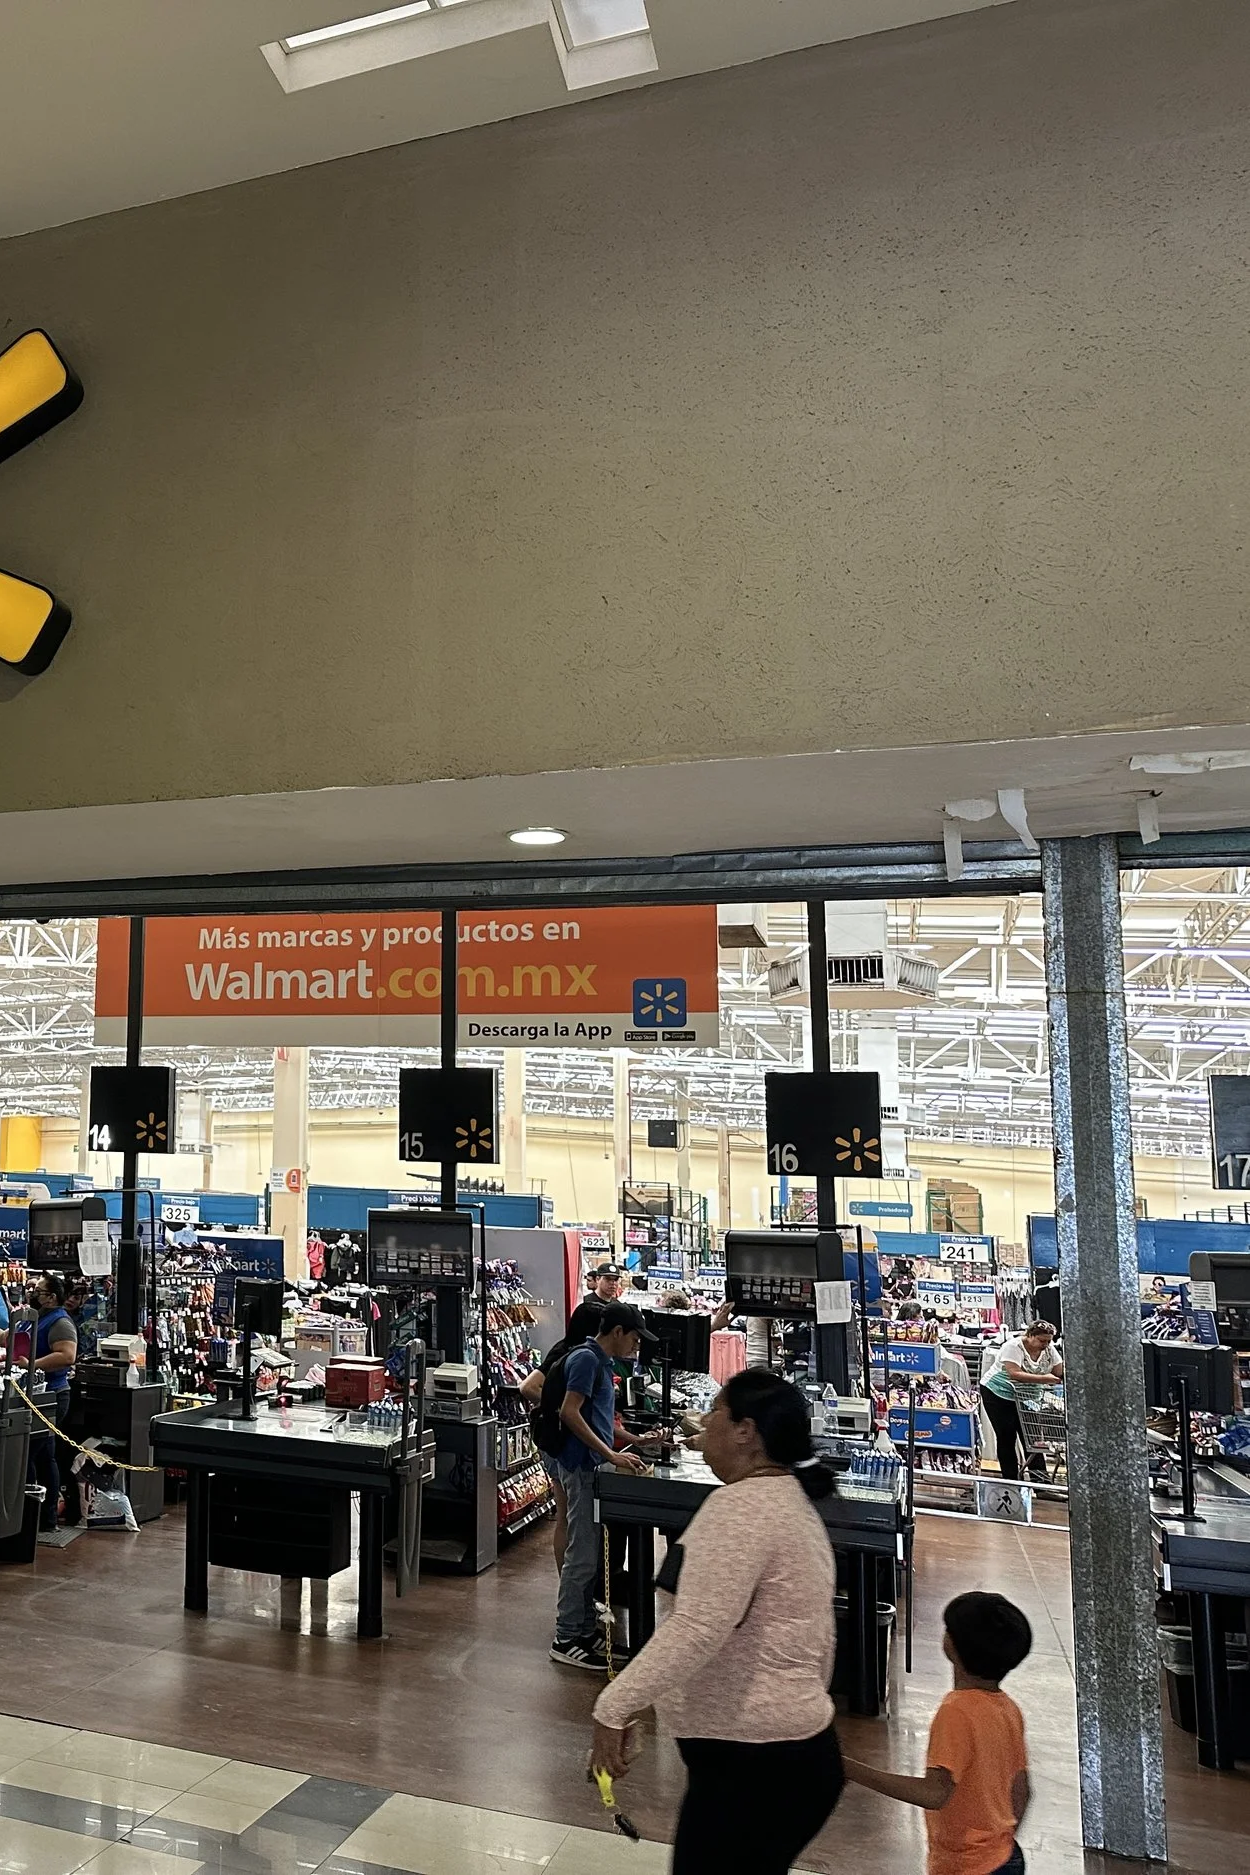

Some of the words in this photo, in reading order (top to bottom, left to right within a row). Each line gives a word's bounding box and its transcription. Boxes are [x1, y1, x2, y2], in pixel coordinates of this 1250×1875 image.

[199, 927, 250, 949] Más
[257, 927, 353, 948] marcas
[360, 928, 377, 951] y
[542, 921, 580, 941] en
[185, 959, 598, 1000] Walmart.com.mx
[468, 1022, 549, 1040] Descarga
[554, 1022, 572, 1037] la
[574, 1022, 613, 1040] App
[89, 1124, 111, 1151] 14
[400, 1132, 425, 1160] 15
[768, 1143, 800, 1173] 16
[1219, 1154, 1250, 1188] 17
[423, 1194, 439, 1204] bajo
